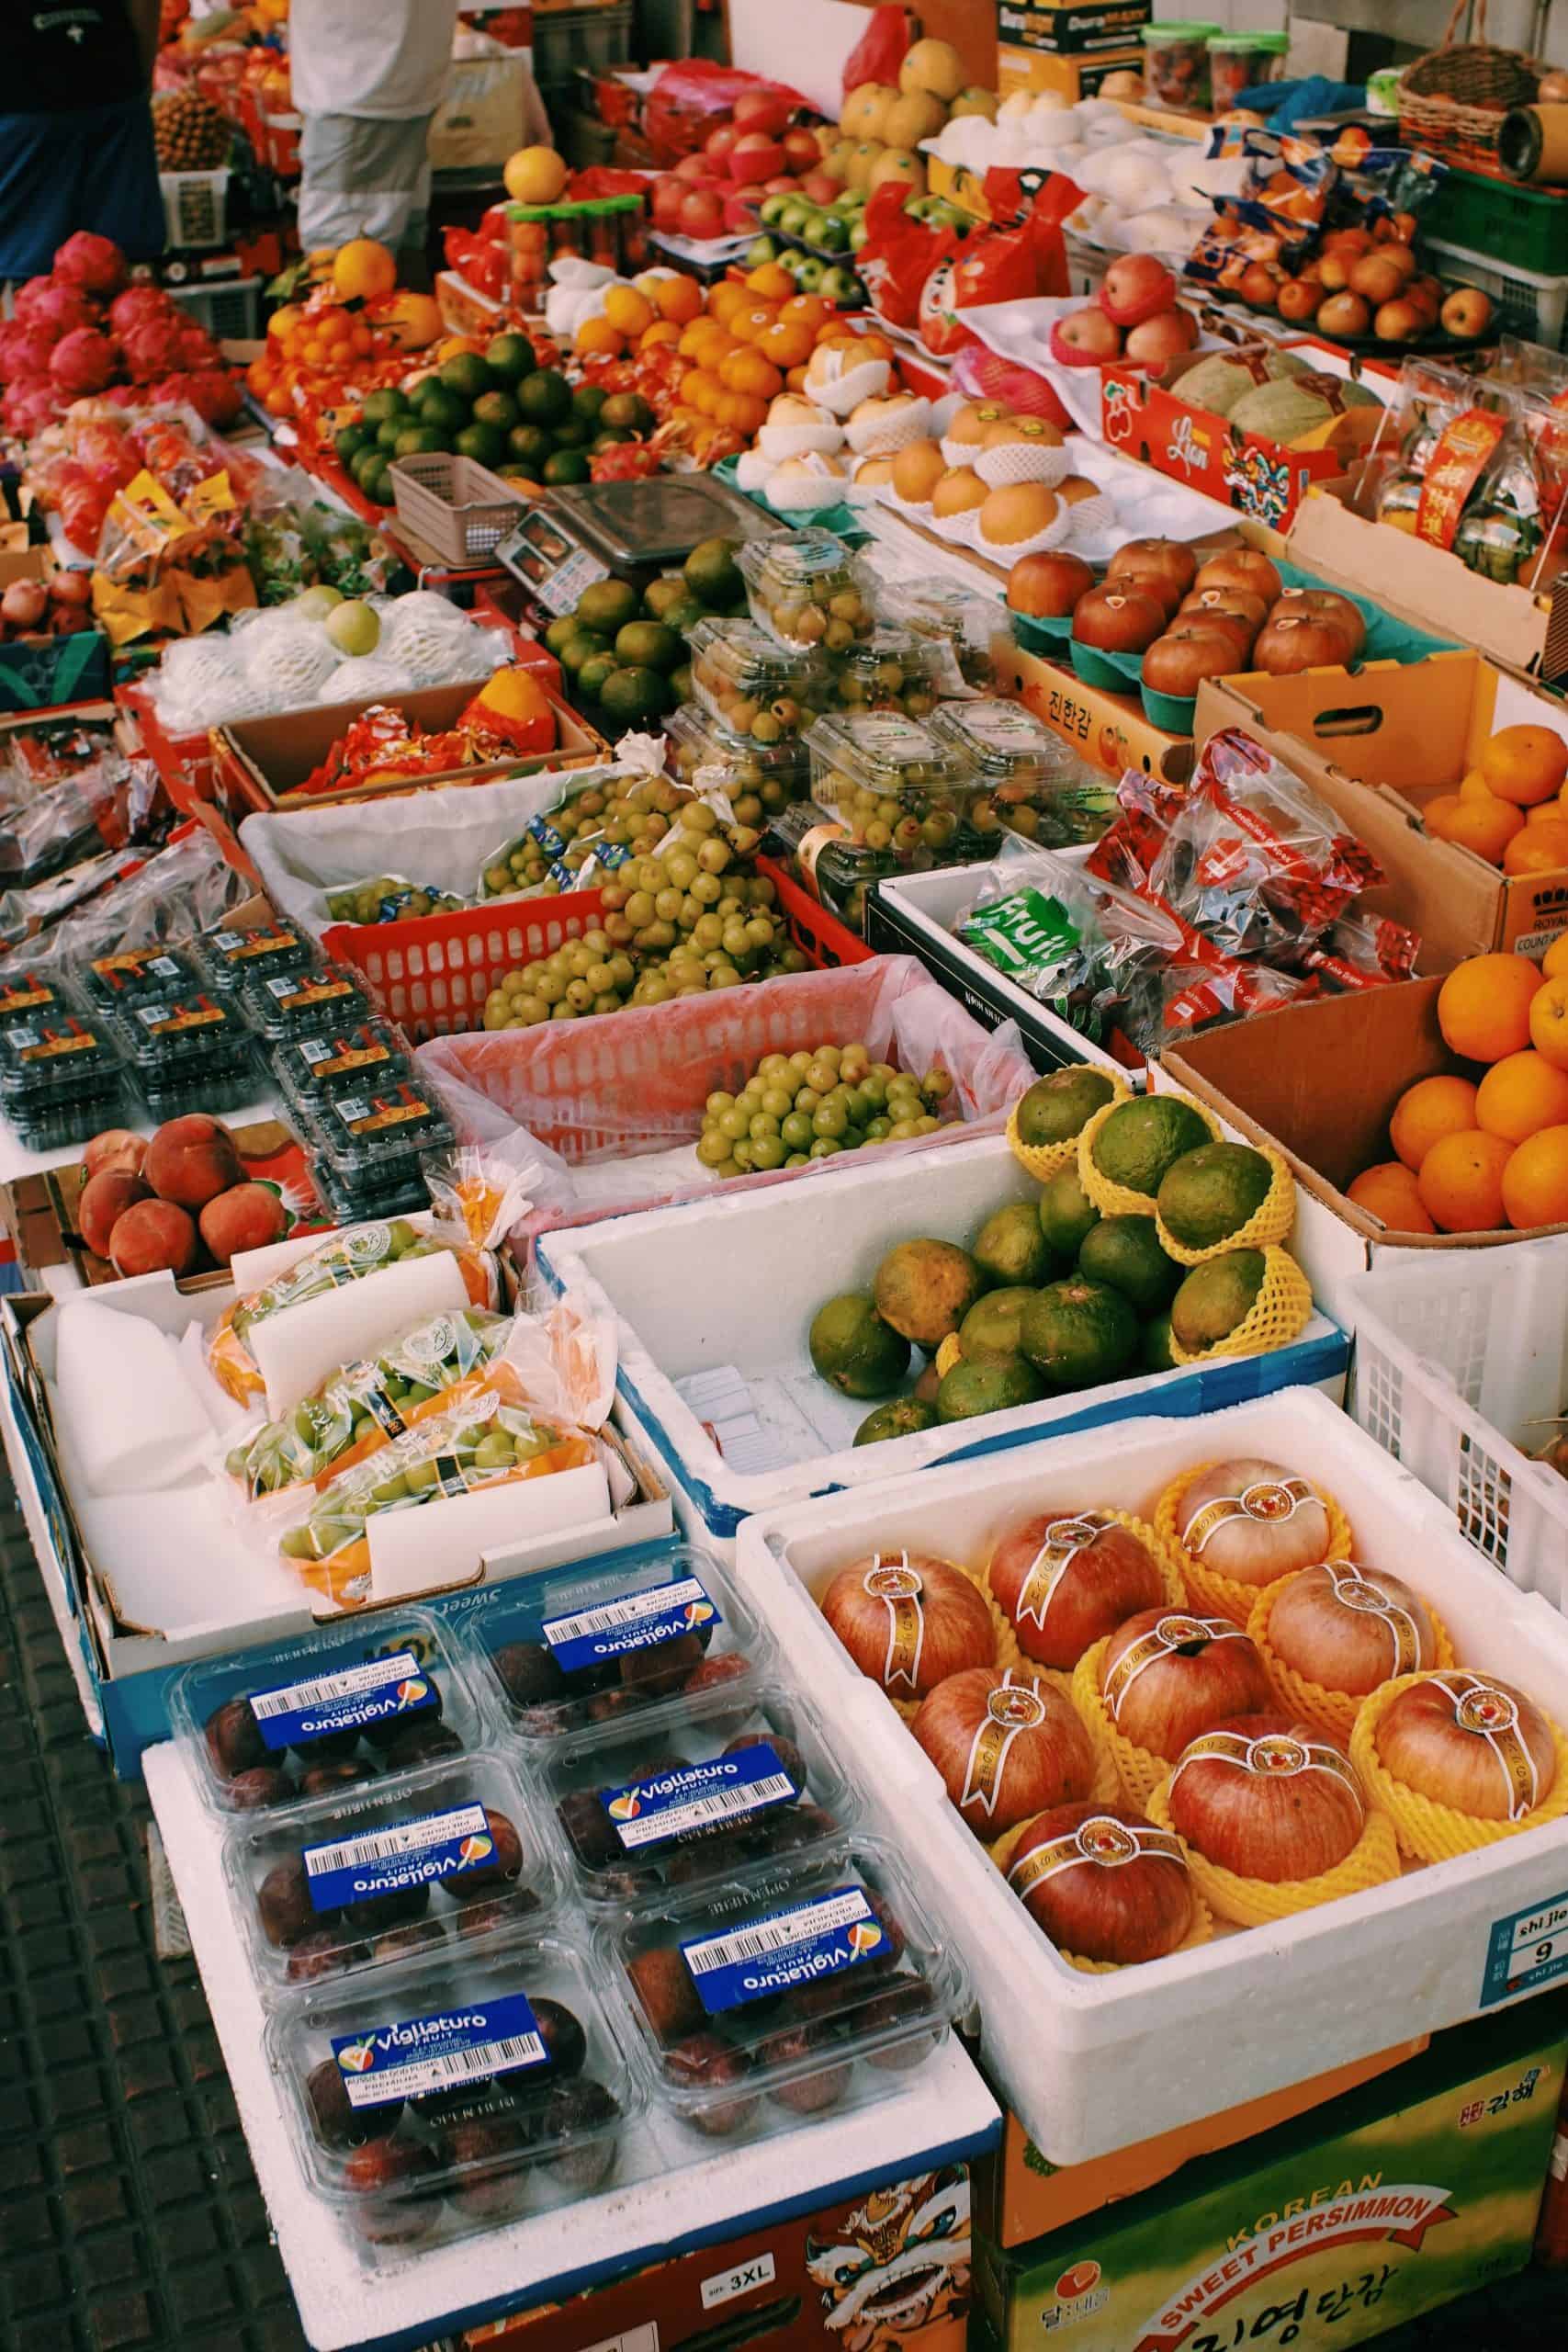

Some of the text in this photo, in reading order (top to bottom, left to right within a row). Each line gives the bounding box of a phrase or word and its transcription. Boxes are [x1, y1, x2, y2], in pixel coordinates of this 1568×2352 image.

[1168, 415, 1209, 477] Lion
[1049, 690, 1092, 741] 진한감
[987, 897, 1070, 960] Fruit
[593, 1620, 685, 1654] Vigliaturo
[300, 1697, 397, 1733] Vigliaturo
[640, 1763, 739, 1800] Vigliaturo
[353, 1857, 457, 1894] Vigliaturo
[1519, 1917, 1543, 1937] shi
[742, 1946, 848, 1992] Vigliaturo
[1535, 1940, 1553, 1964] 9
[377, 2014, 487, 2052] Vigliaturo
[1226, 2172, 1383, 2254] KOREAN
[729, 2264, 771, 2291] 3XL
[1160, 2251, 1259, 2330] SWEET
[1268, 2194, 1432, 2256] PERSIMMON
